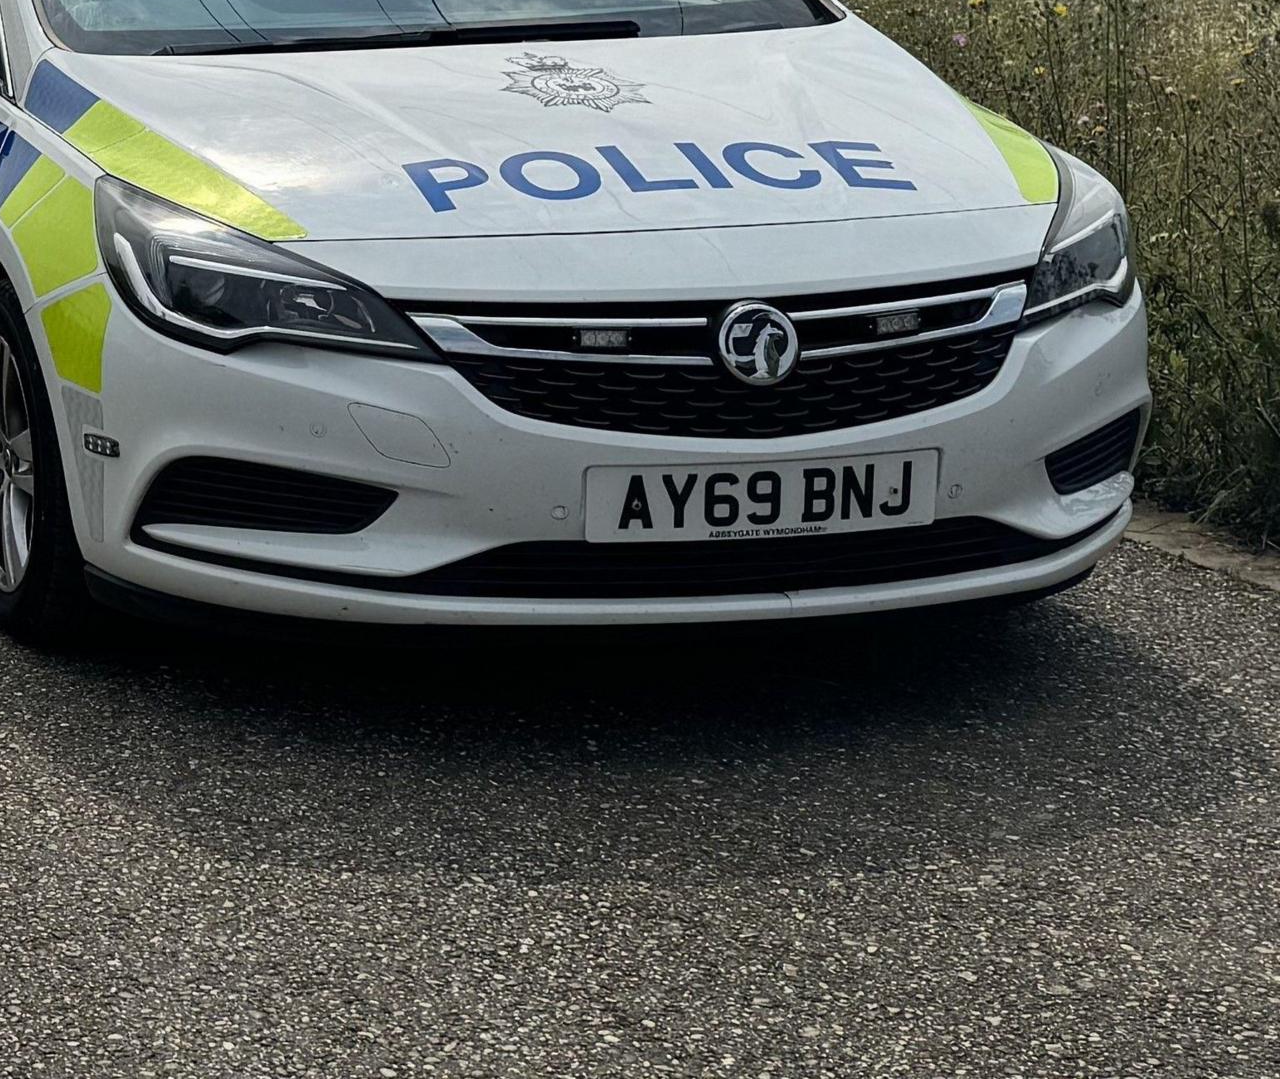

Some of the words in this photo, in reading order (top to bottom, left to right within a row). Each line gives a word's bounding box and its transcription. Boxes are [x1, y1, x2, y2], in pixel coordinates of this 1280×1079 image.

[401, 140, 918, 213] POLICE
[618, 471, 782, 529] AY69
[801, 461, 913, 523] BNJ
